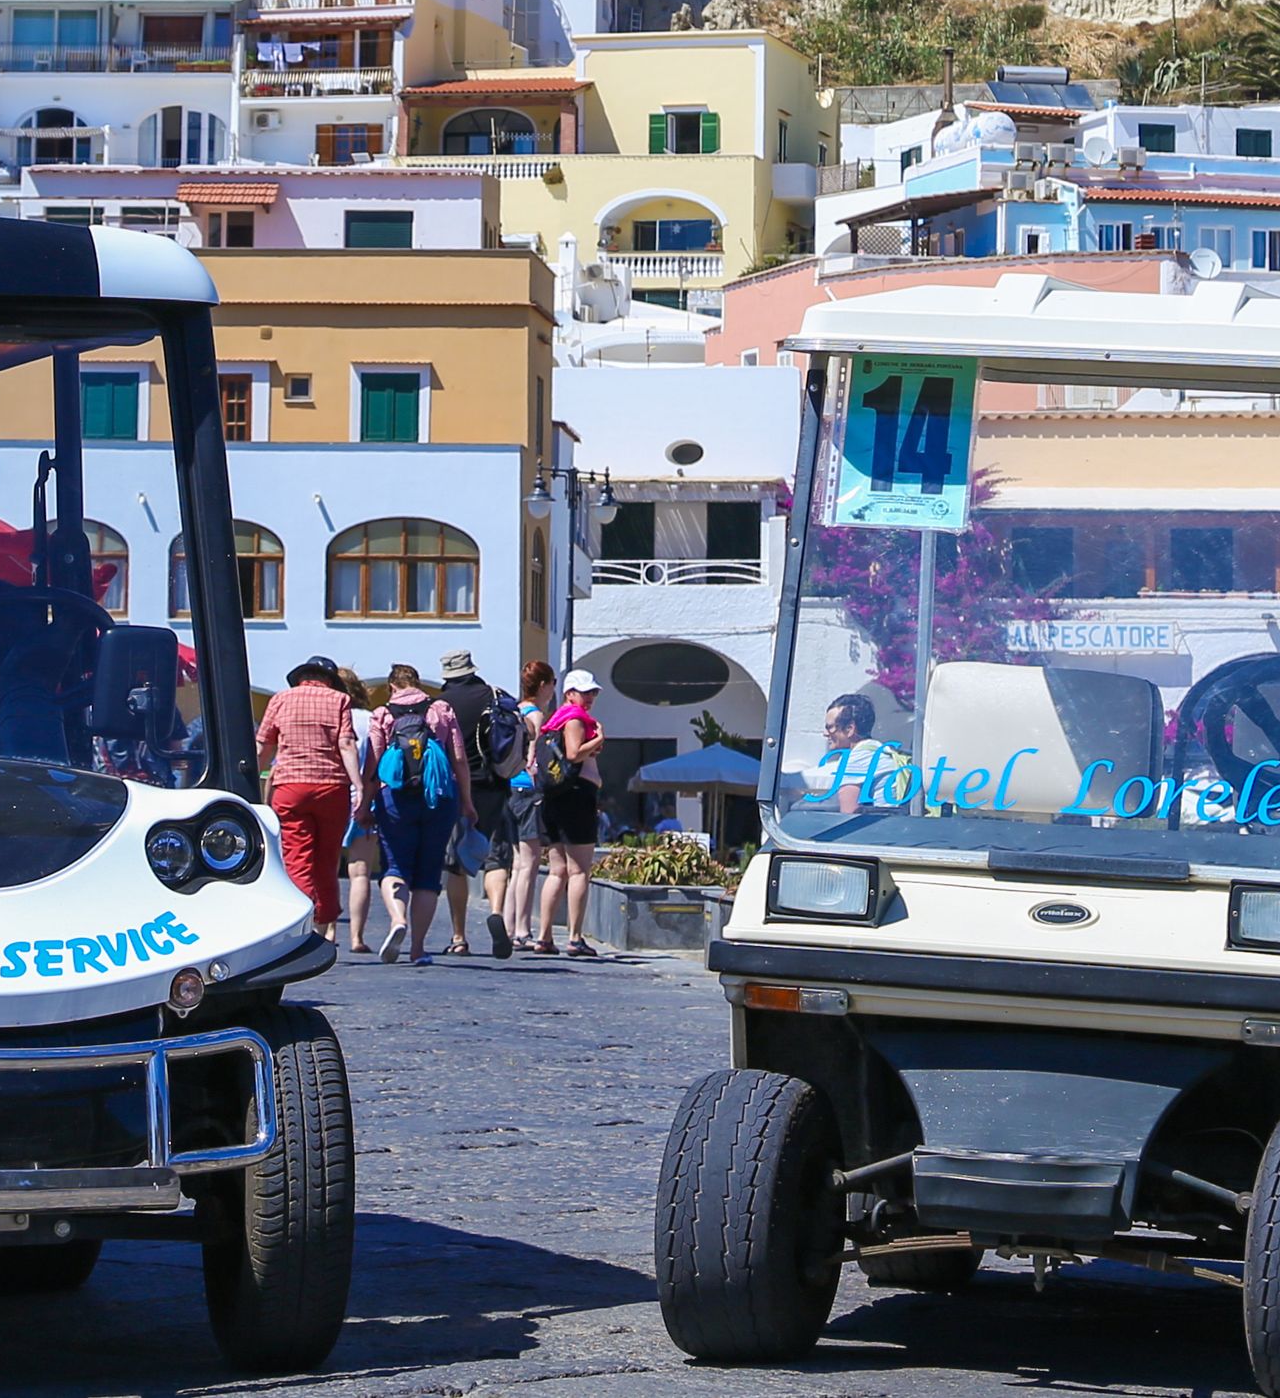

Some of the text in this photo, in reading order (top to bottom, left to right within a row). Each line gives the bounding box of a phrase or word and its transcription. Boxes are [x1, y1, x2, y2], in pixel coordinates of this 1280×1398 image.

[862, 375, 954, 494] 14
[1047, 625, 1169, 648] PESCATORE
[802, 740, 1039, 811] Hotel
[0, 910, 201, 978] SERVICE
